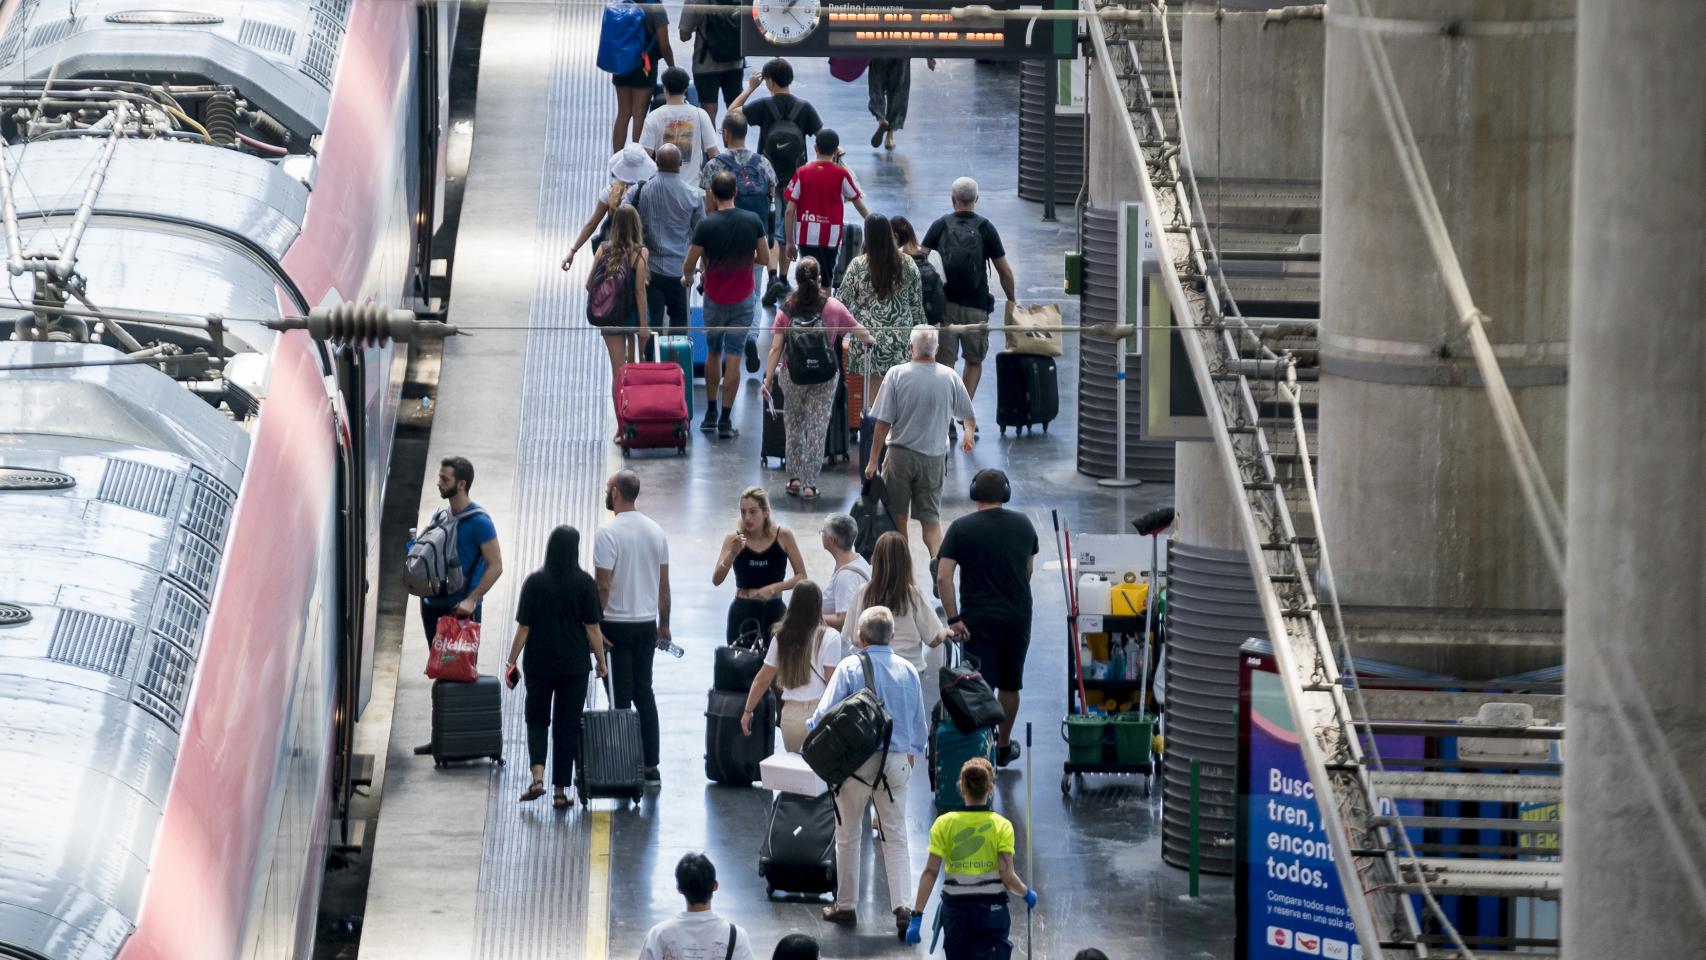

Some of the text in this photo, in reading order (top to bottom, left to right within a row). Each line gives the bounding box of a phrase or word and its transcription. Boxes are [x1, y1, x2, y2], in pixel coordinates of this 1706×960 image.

[828, 2, 861, 12] Destino
[1019, 4, 1043, 47] 7
[801, 209, 816, 222] ria
[1268, 767, 1315, 800] Busc
[1267, 798, 1315, 833] tren,
[1266, 831, 1336, 862] encont
[949, 859, 994, 869] vectalia
[1266, 856, 1329, 889] todos.
[1266, 889, 1303, 907] Compara
[1303, 899, 1325, 912] todos
[1325, 904, 1346, 916] estos
[1266, 904, 1358, 933] y reserva en una sola ap
